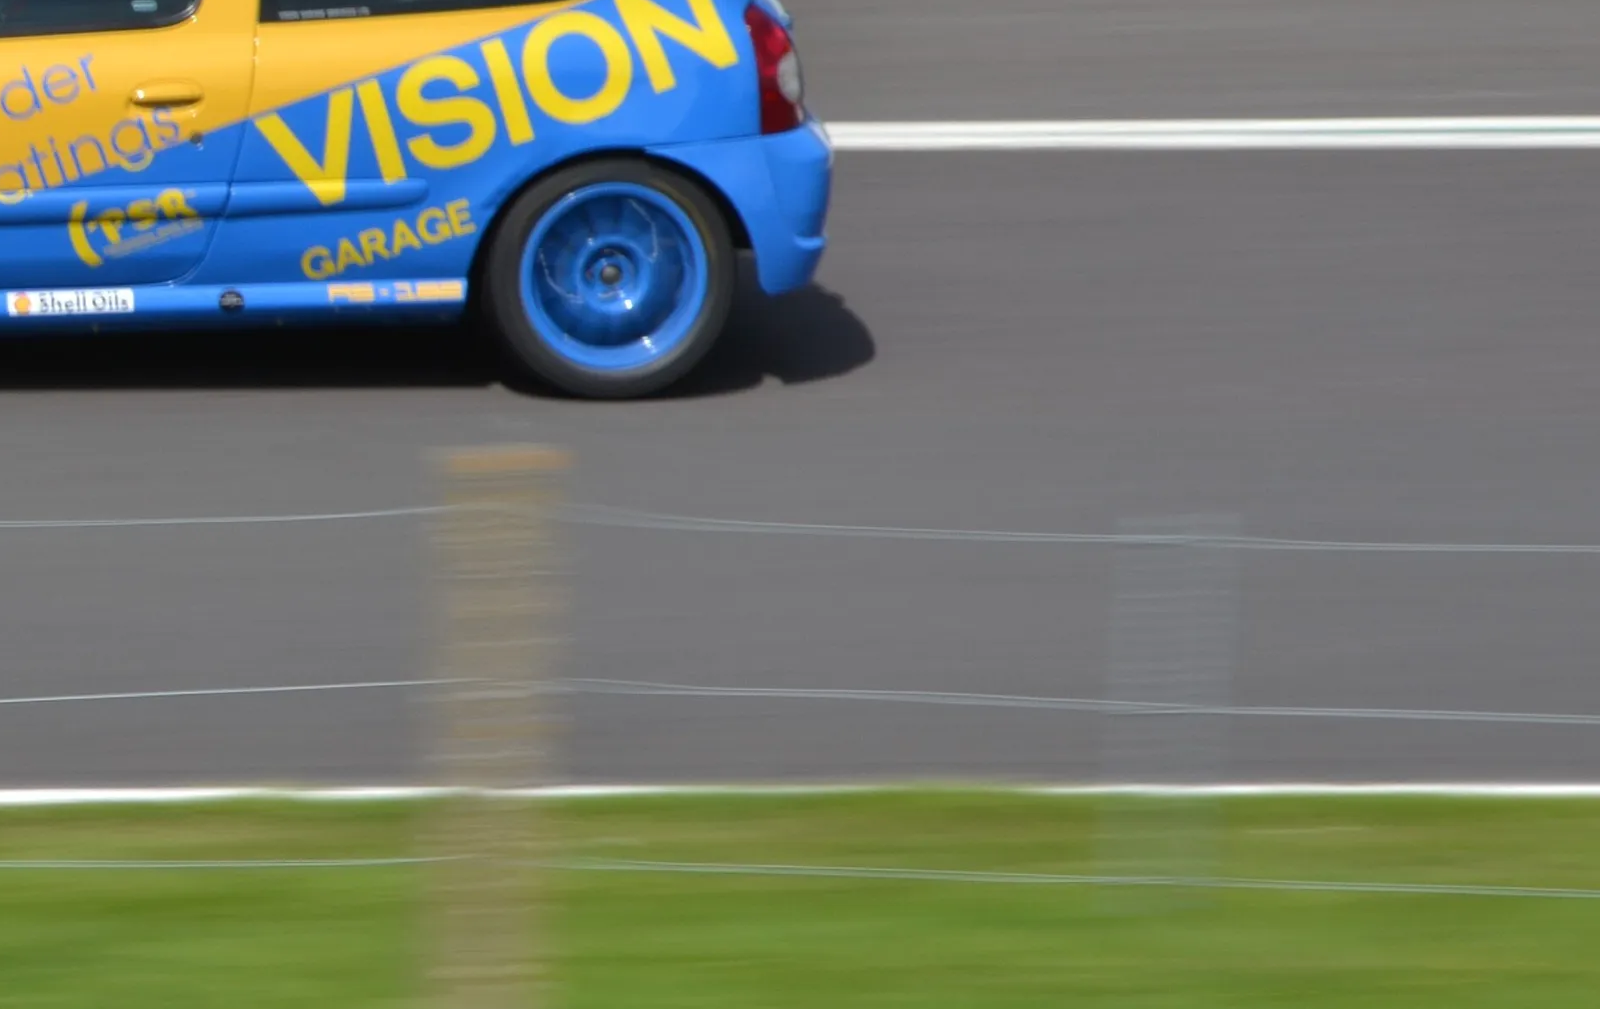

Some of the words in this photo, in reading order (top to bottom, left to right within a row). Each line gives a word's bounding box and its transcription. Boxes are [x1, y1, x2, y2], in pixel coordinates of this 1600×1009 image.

[301, 198, 477, 280] GARAGE
[39, 292, 87, 313] Shell
[91, 290, 130, 312] Oils
